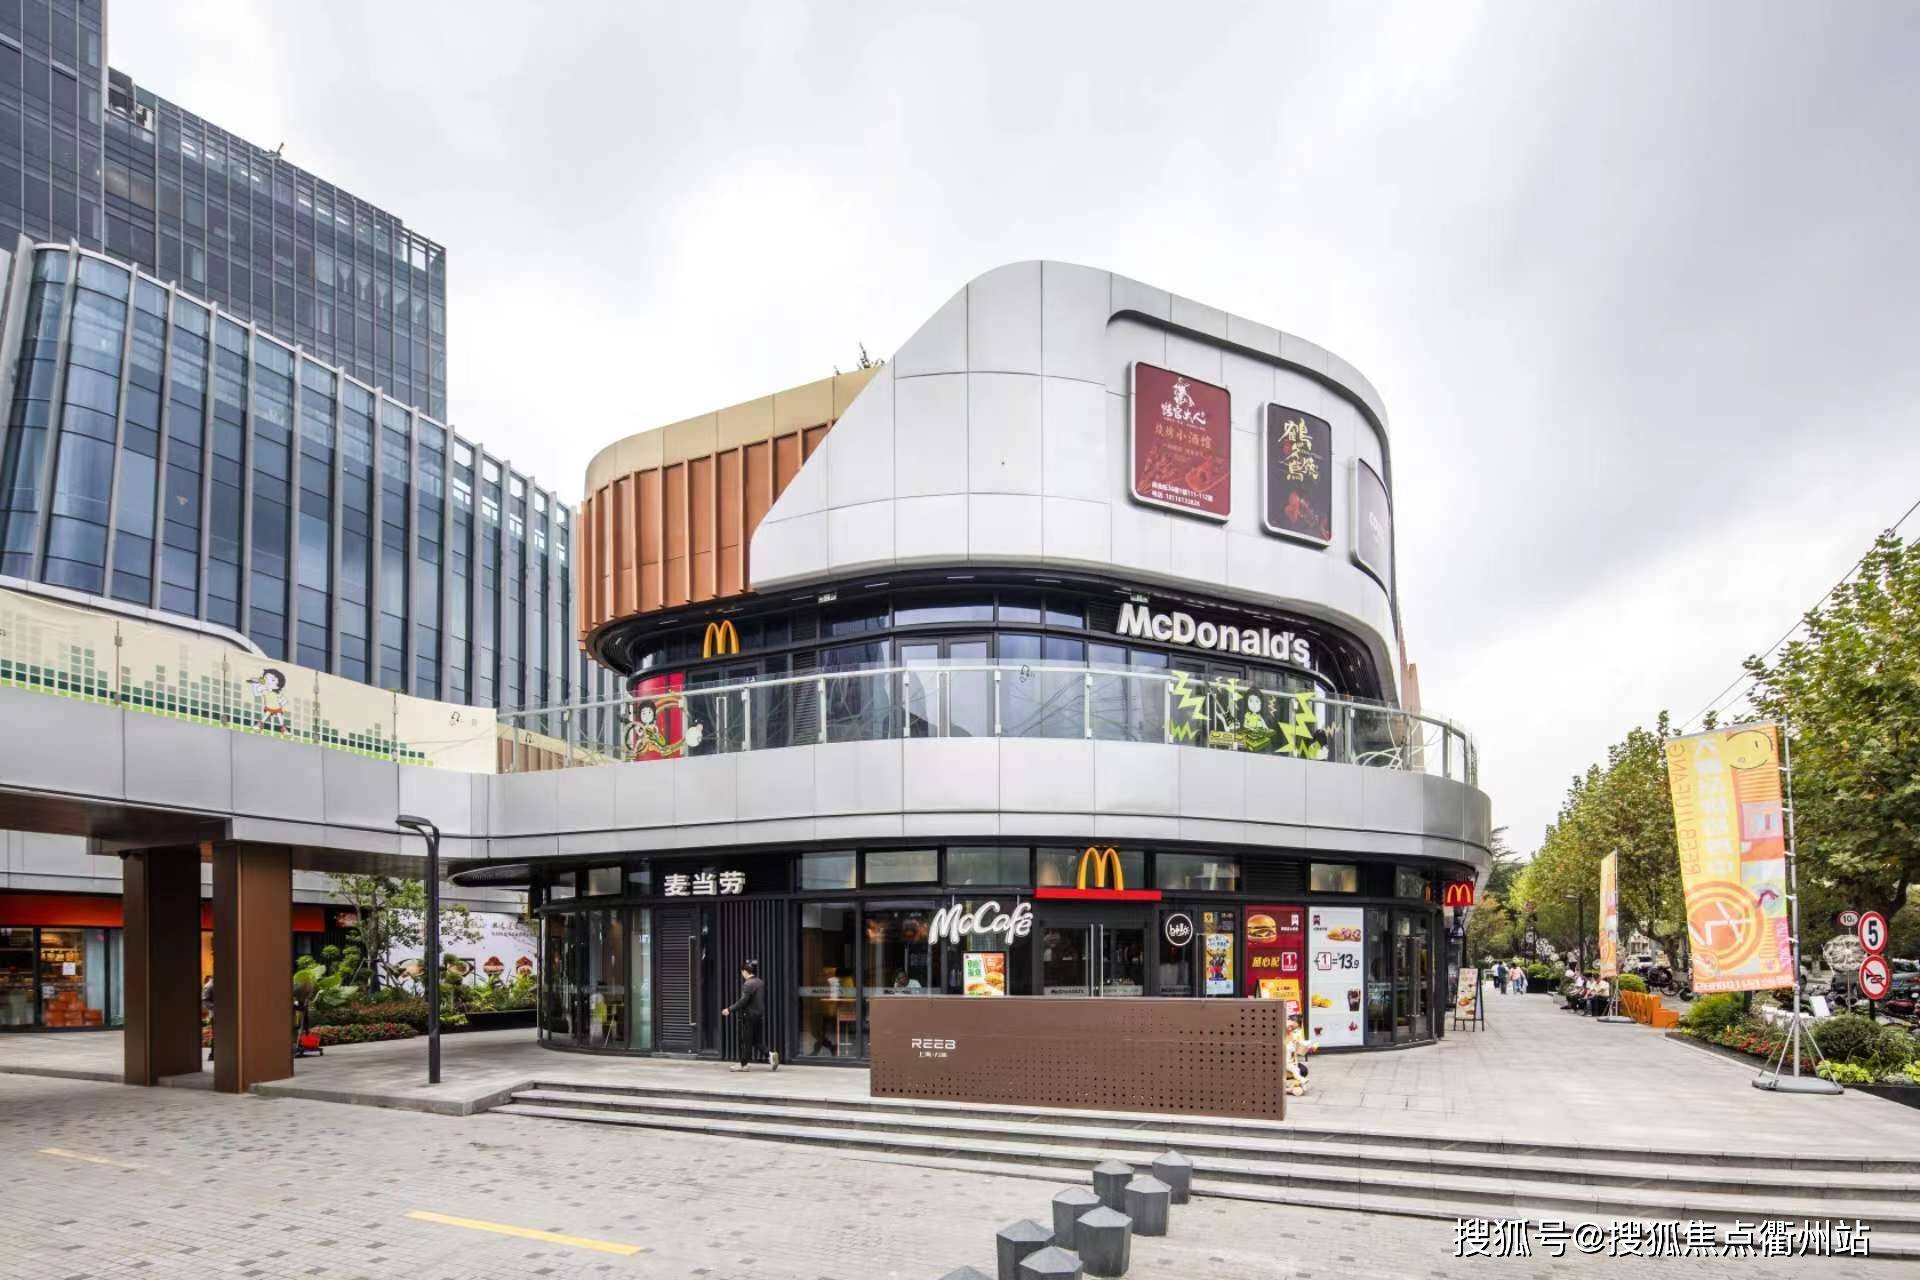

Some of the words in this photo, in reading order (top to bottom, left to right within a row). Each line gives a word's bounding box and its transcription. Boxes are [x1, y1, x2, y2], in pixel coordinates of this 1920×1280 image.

[1116, 602, 1311, 668] McDonald's
[664, 870, 746, 897] 麦当劳
[928, 900, 1034, 945] McCafé
[1868, 920, 1878, 947] 5
[911, 1038, 957, 1050] REEB
